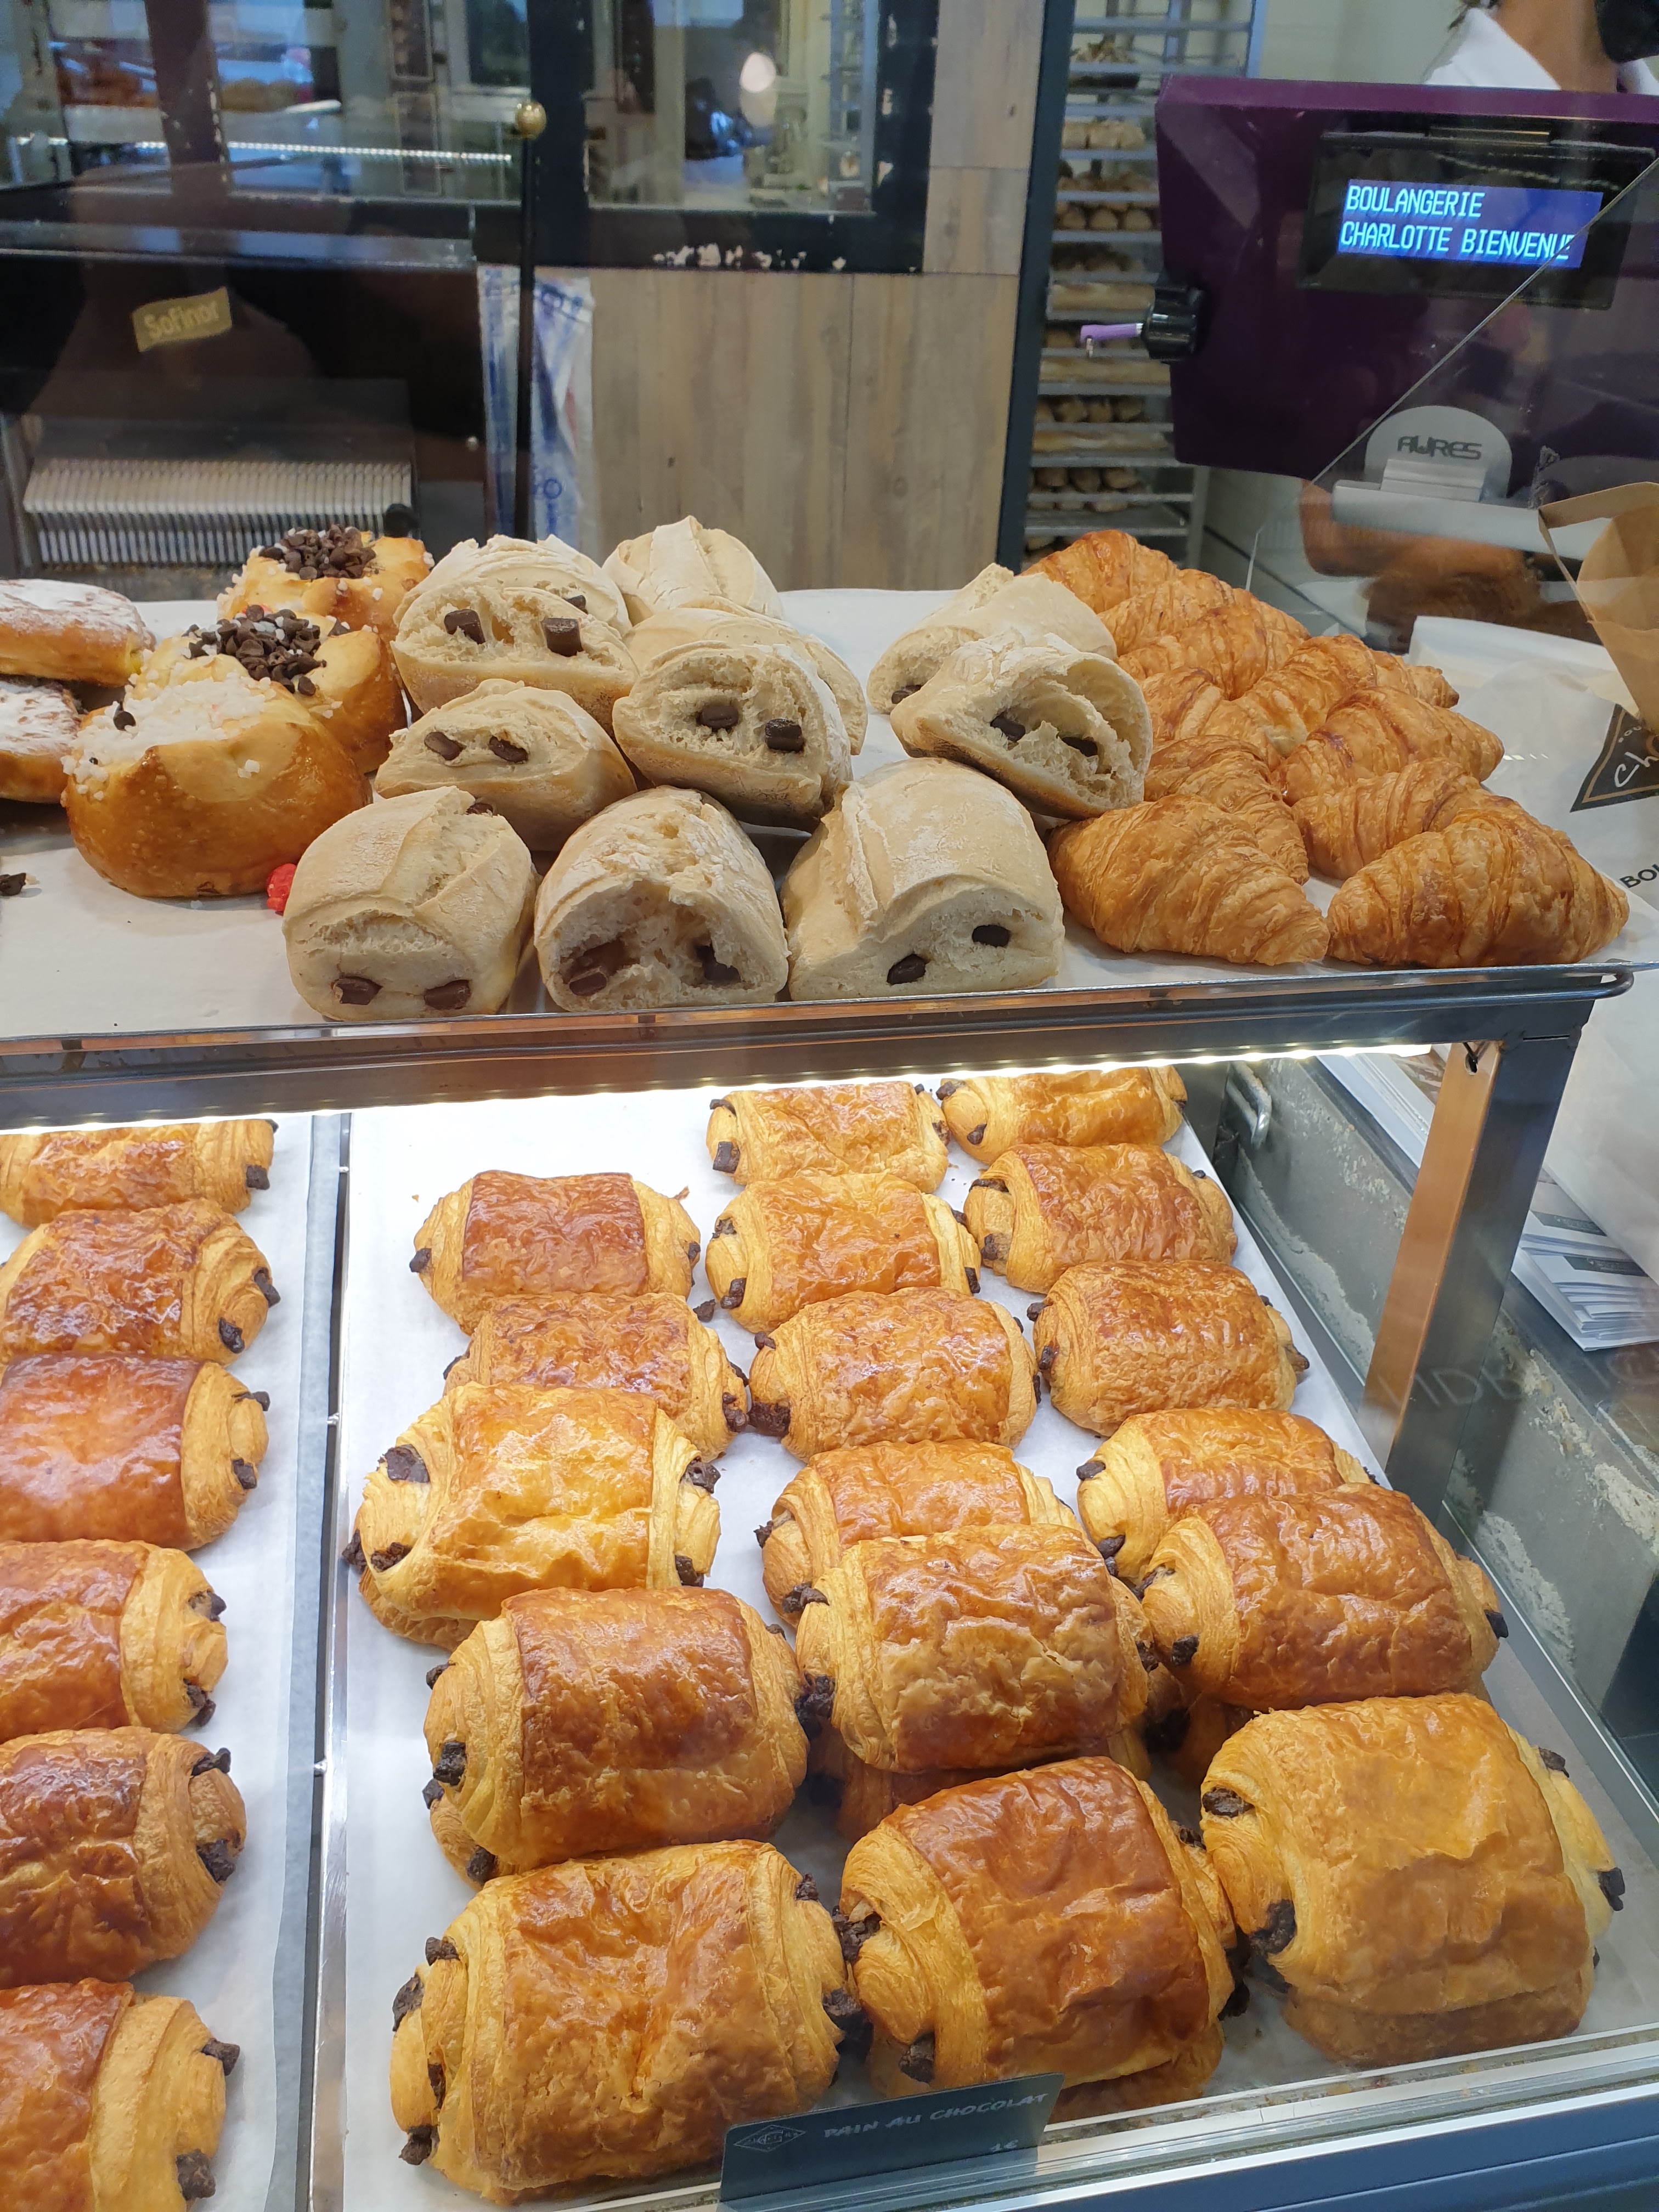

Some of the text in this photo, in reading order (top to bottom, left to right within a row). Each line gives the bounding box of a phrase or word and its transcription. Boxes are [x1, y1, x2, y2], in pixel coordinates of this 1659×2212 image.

[1345, 185, 1486, 218] BOULANGERIE
[1340, 222, 1453, 252] CHARLOTTE
[824, 2093, 1048, 2138] PAIN AU CHOCOLAT
